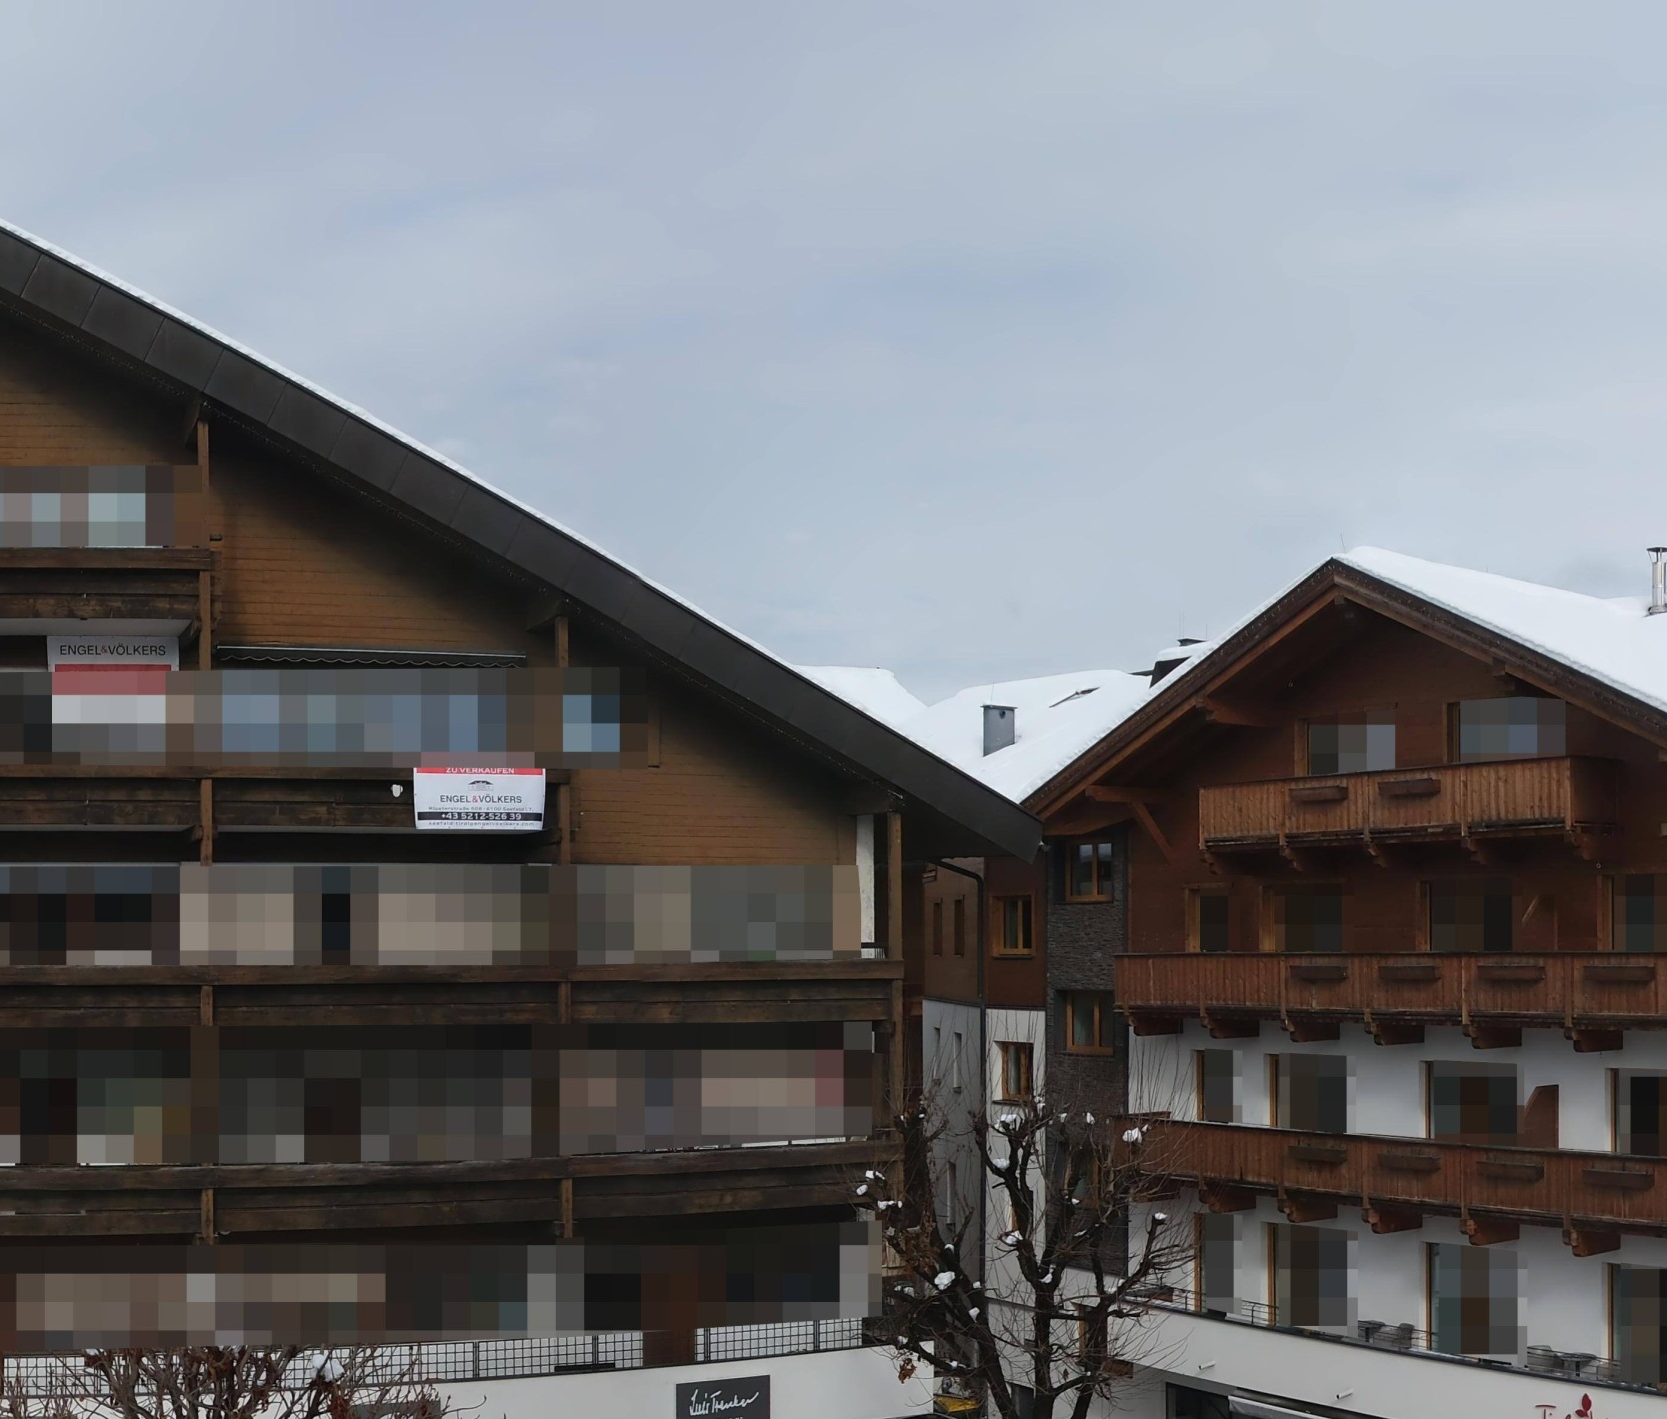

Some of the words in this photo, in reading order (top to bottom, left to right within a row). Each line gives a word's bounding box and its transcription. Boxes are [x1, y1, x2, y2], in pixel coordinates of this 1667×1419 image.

[59, 643, 167, 656] ENGEL&VÖLKERS
[440, 794, 523, 804] ENGEL&VÖLKERS
[461, 812, 507, 820] 5212-526
